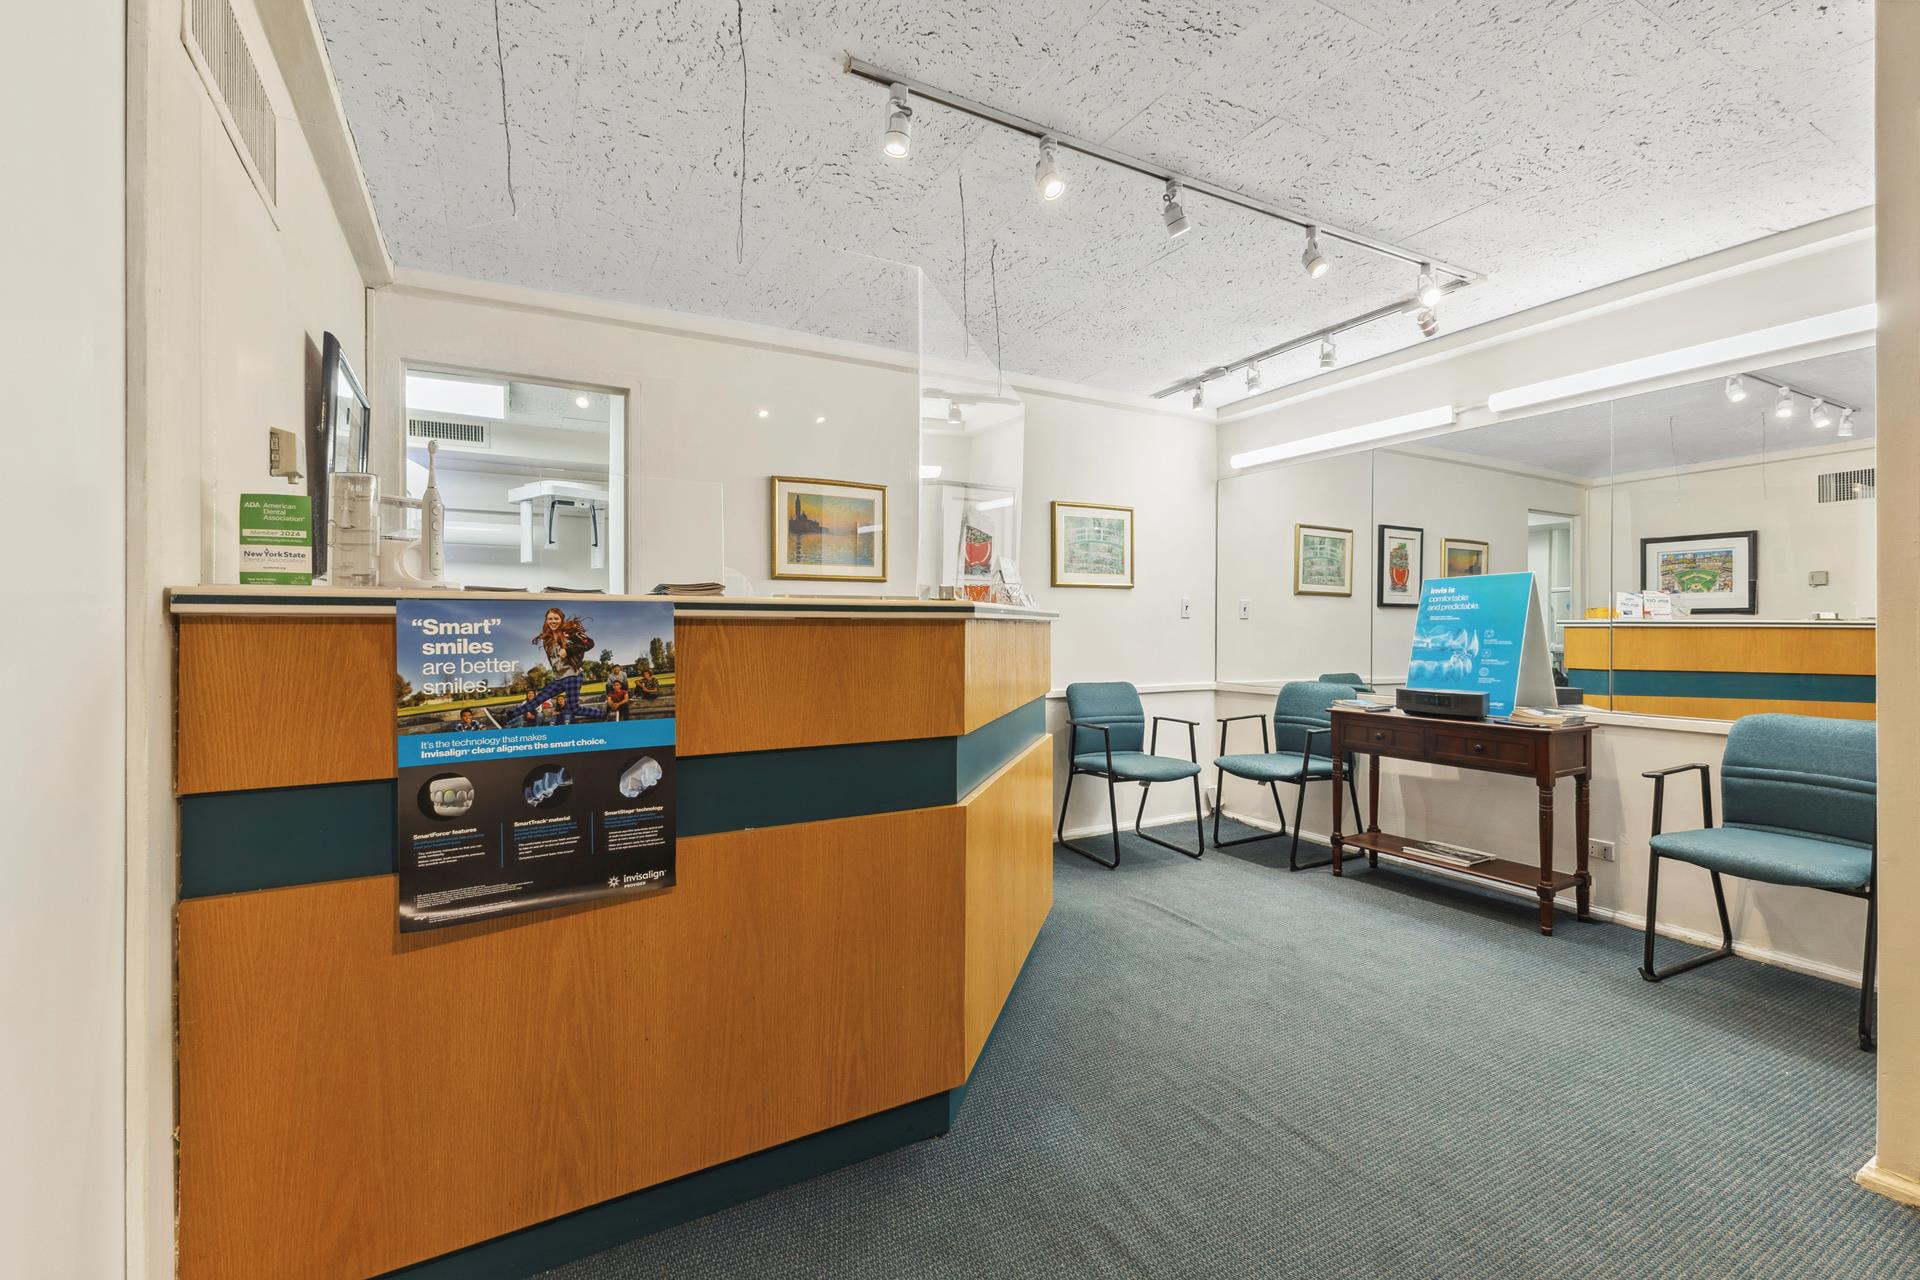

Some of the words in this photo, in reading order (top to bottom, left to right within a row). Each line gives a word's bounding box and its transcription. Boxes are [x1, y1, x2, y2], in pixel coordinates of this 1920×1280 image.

[263, 502, 296, 510] American
[264, 549, 283, 558] York
[283, 551, 306, 559] State
[411, 618, 502, 635] “Smart”
[422, 638, 494, 655] smiles
[422, 661, 457, 675] are
[460, 657, 520, 674] better
[422, 677, 492, 695] smiles.
[420, 741, 435, 750] It's
[435, 740, 451, 748] the
[451, 736, 501, 748] technology
[502, 735, 518, 743] that
[520, 733, 548, 742] makes
[420, 747, 468, 759] Invisalign
[471, 745, 495, 755] clear
[496, 743, 533, 754] aligners
[534, 741, 549, 750] the
[550, 739, 575, 748] smart
[576, 736, 608, 747] choice.
[636, 805, 664, 814] technology
[548, 815, 571, 823] material
[451, 827, 478, 836] features
[623, 870, 665, 883] invisalign
